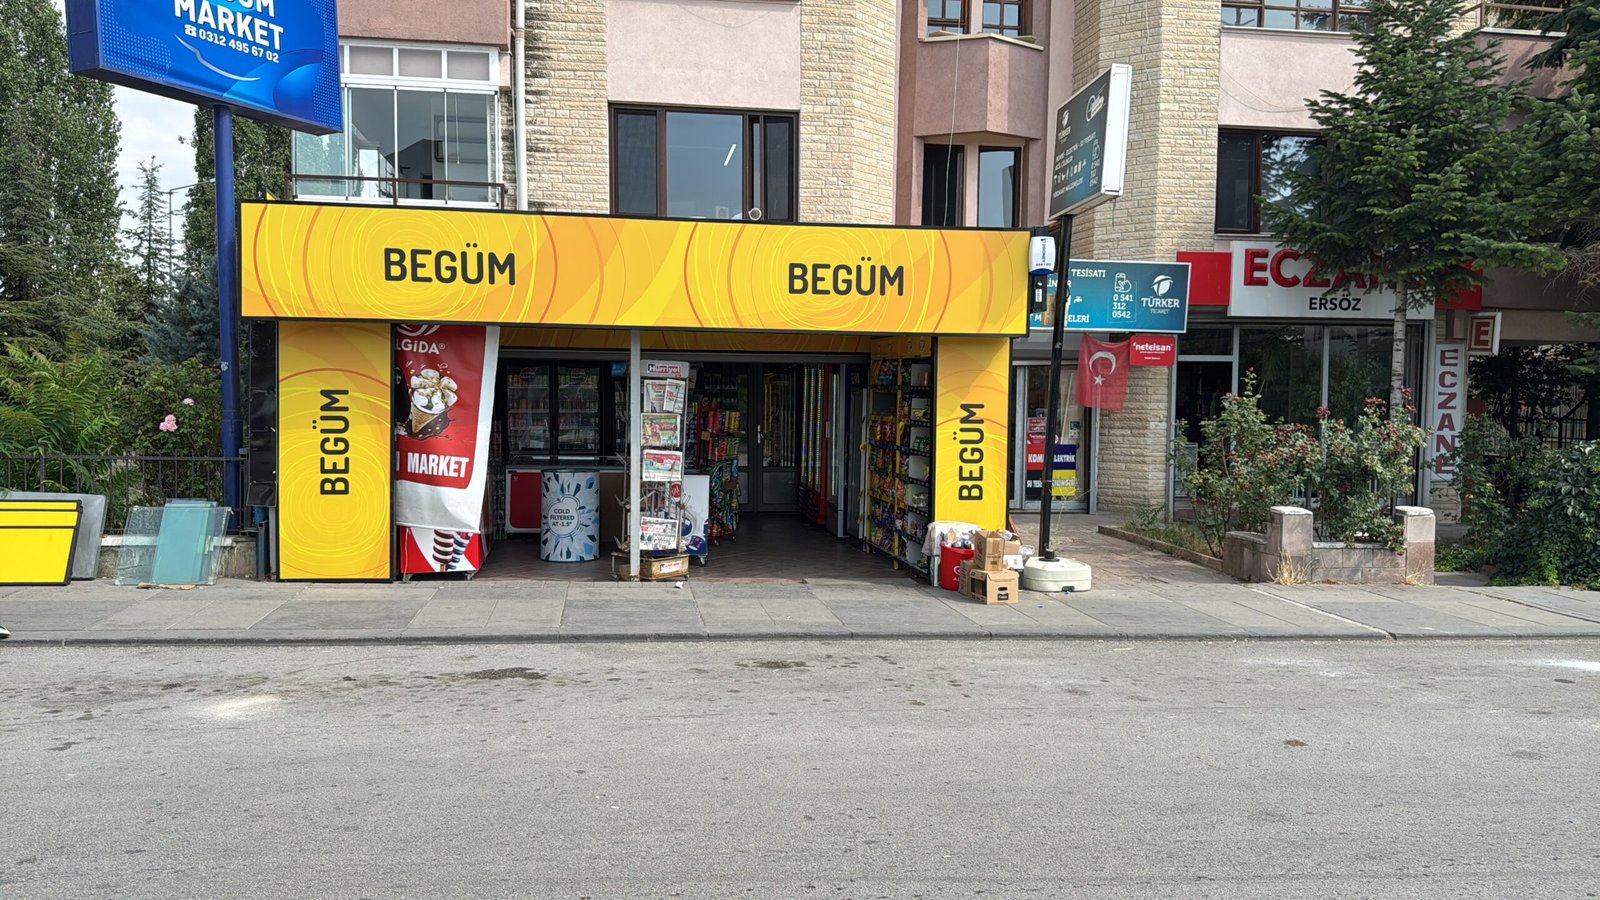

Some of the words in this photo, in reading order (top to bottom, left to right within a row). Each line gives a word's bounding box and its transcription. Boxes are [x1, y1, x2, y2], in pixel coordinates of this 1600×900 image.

[174, 0, 284, 50] MARKET
[199, 29, 226, 46] 0312
[229, 39, 249, 54] 495
[251, 46, 264, 58] 67
[266, 51, 279, 63] 02
[384, 242, 515, 286] BEGÜM
[788, 256, 904, 297] BEGÜM
[1071, 268, 1106, 278] TESİSATI
[1113, 302, 1126, 310] 312
[1120, 294, 1133, 302] 541
[1141, 296, 1180, 308] TÜRKER
[1308, 294, 1361, 311] ERSÖZ
[1474, 321, 1490, 346] E
[1435, 348, 1458, 474] ECZANE
[312, 389, 350, 495] BEGÜM
[952, 403, 985, 501] BEGÜM
[407, 451, 469, 479] MARKET
[1028, 453, 1044, 463] KOM
[1053, 452, 1075, 462] LEKTRİK
